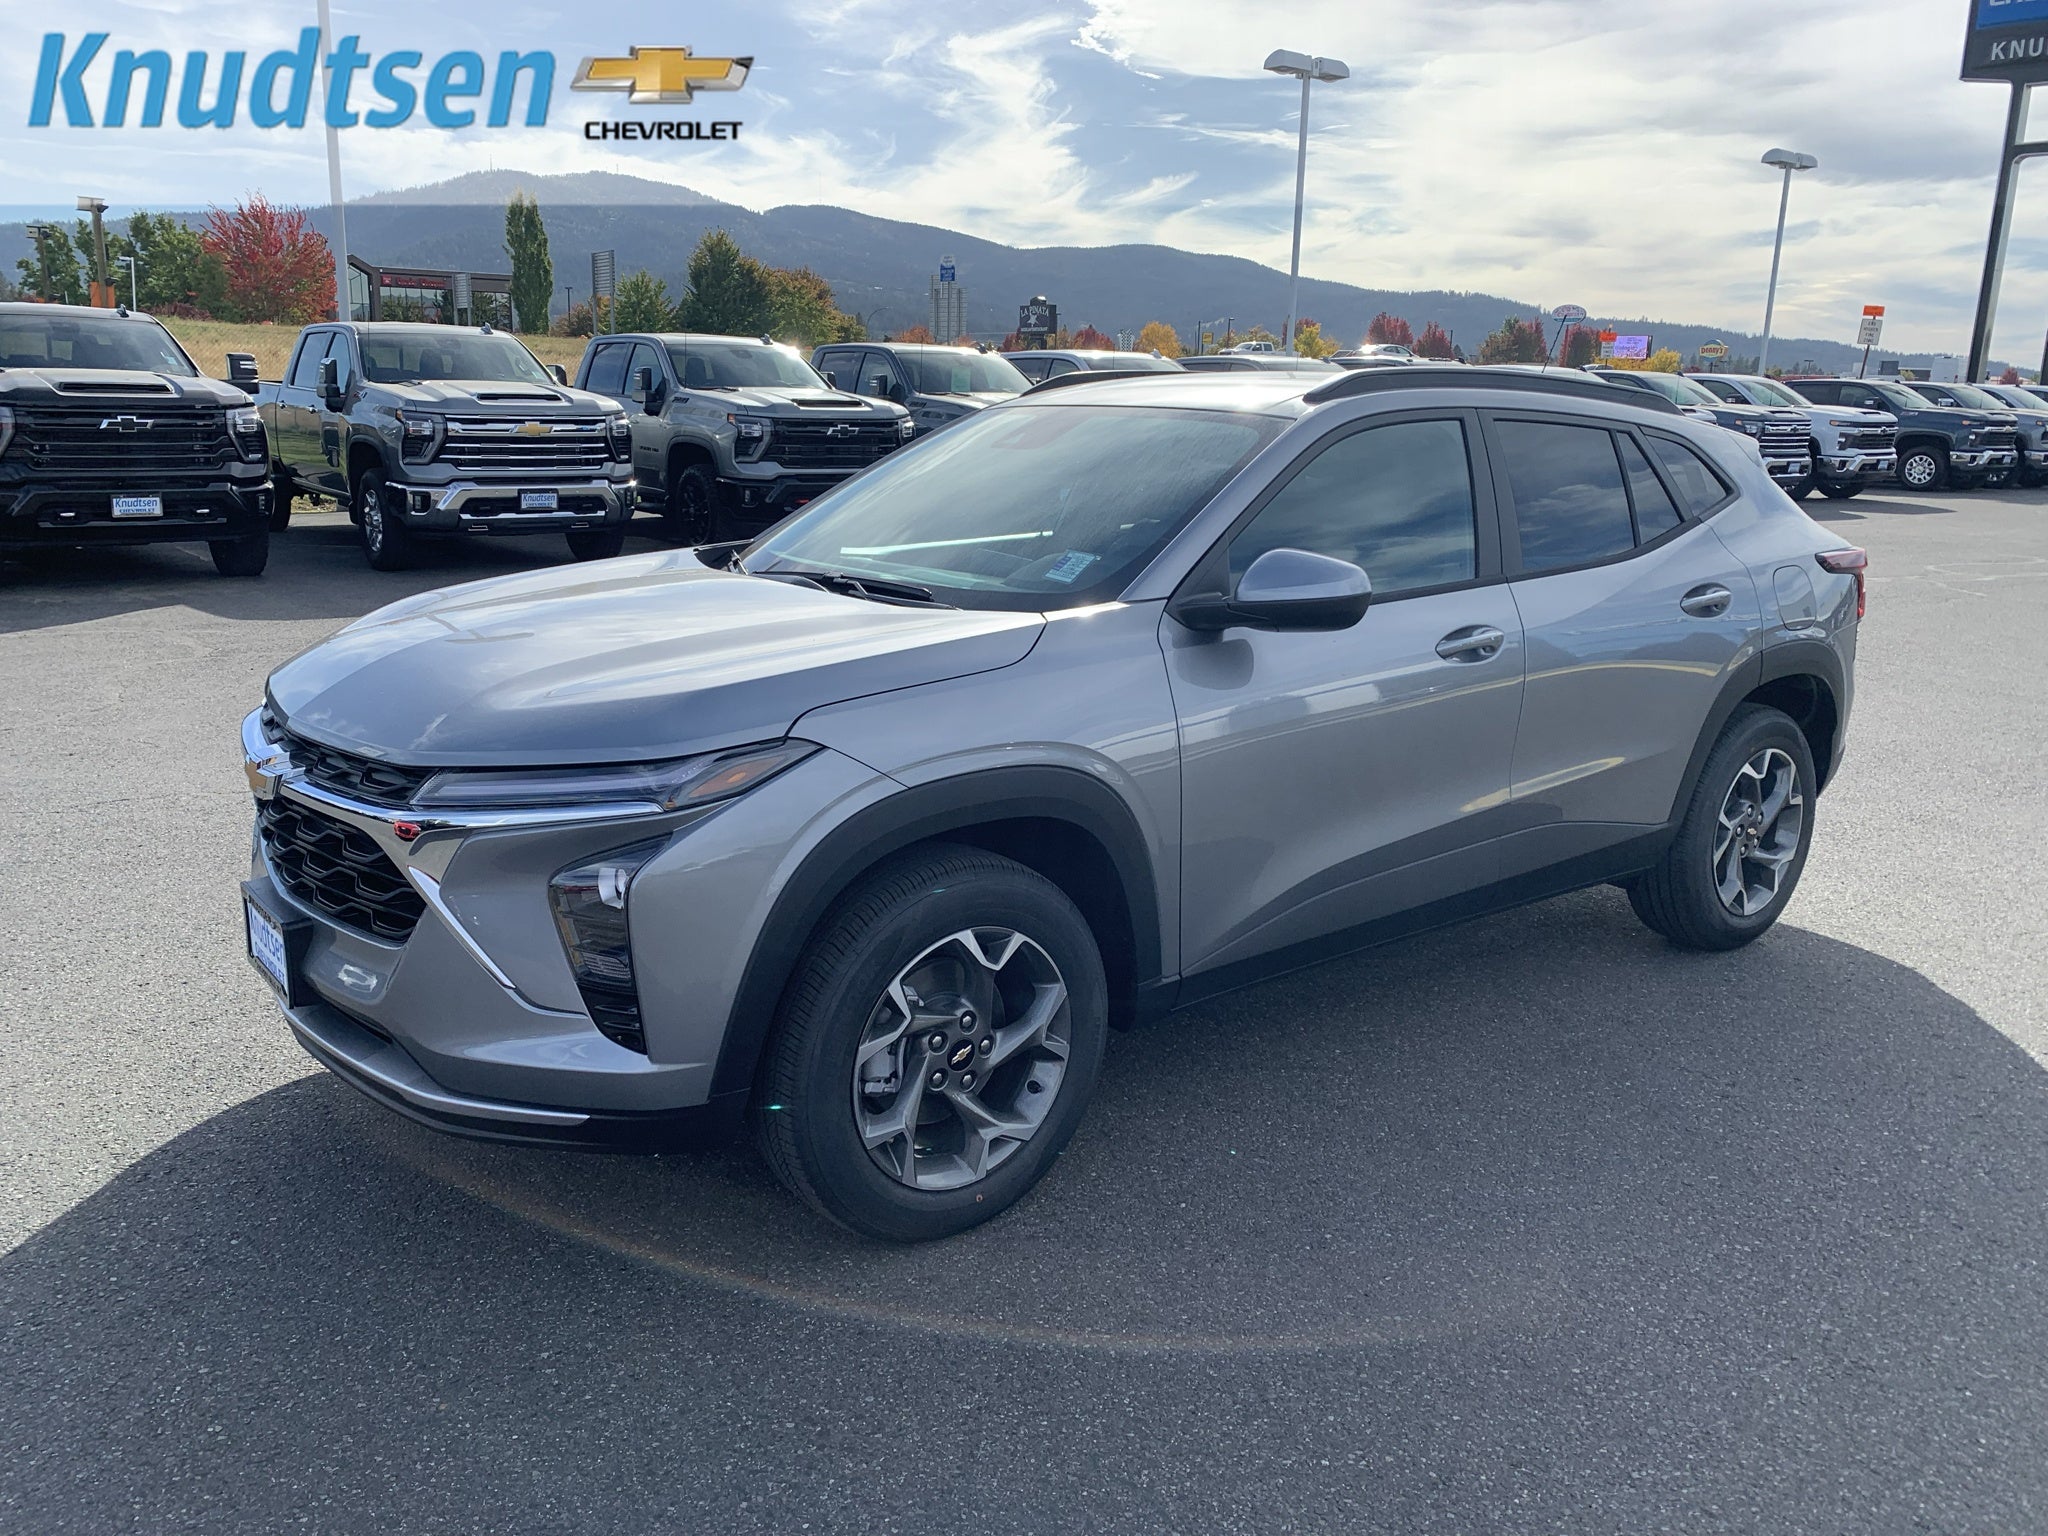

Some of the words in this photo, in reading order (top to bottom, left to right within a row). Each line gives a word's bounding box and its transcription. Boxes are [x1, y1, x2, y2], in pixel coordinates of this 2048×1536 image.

[1991, 36, 2048, 61] KNU
[1020, 308, 1029, 318] LA
[115, 498, 158, 508] Knudtsen
[521, 494, 556, 502] Knudtsen
